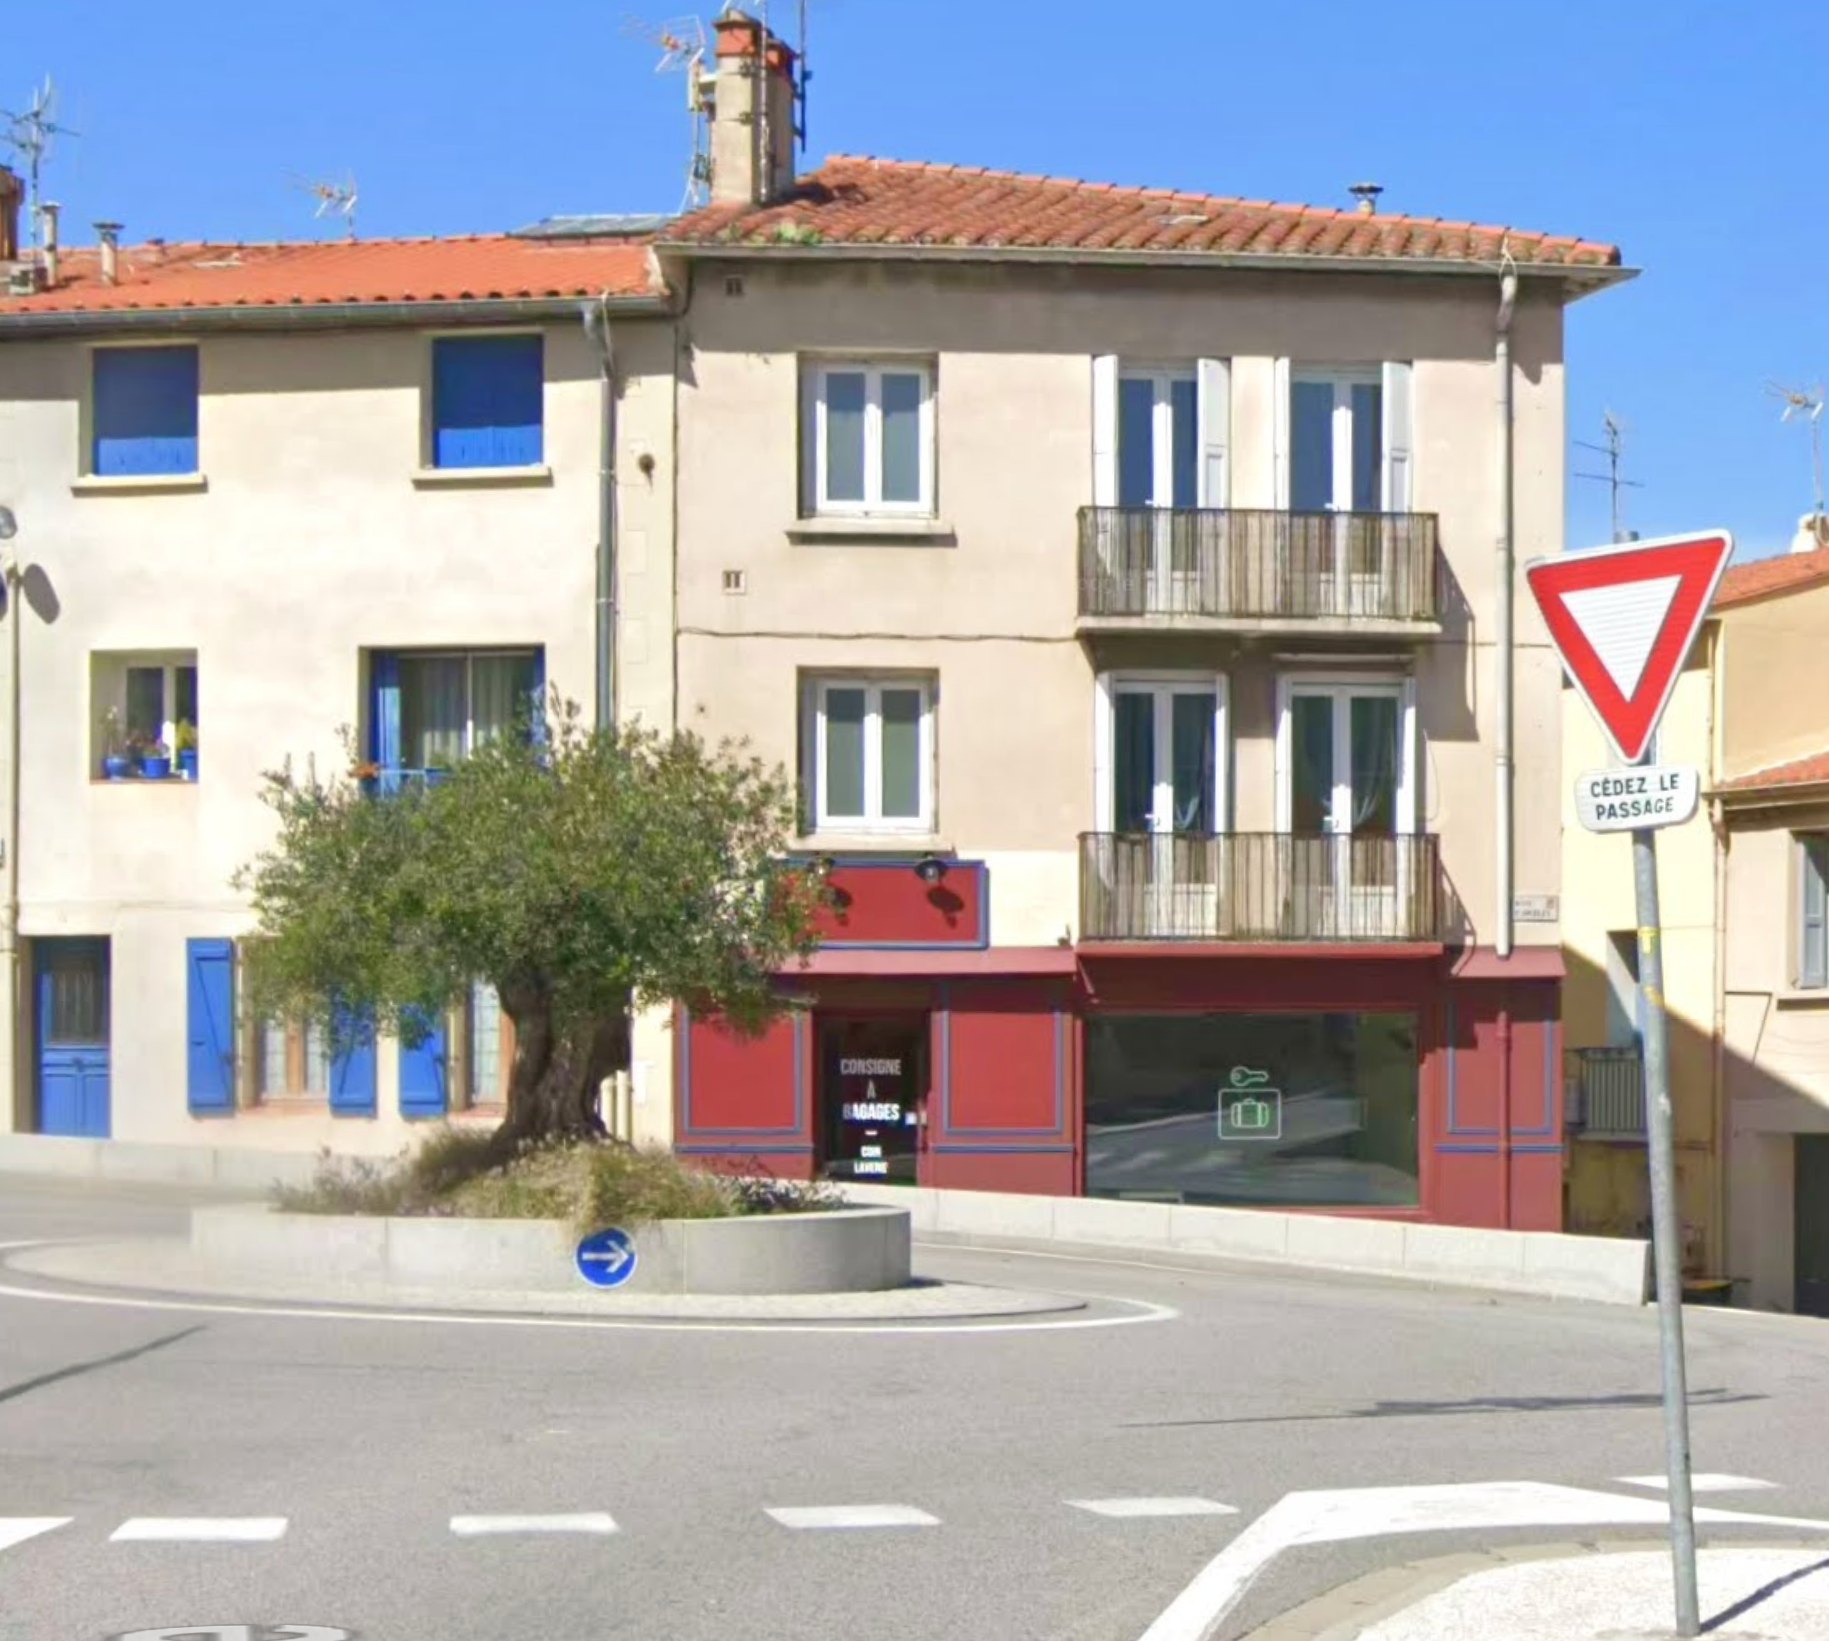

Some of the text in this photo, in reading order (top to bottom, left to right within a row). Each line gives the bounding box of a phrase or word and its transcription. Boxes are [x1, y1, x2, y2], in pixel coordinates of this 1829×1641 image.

[1590, 773, 1680, 798] CÉDEZ LE
[1596, 797, 1675, 820] PASSAGE
[840, 1058, 902, 1075] CONSIGNE
[842, 1102, 900, 1120] BAGAGES
